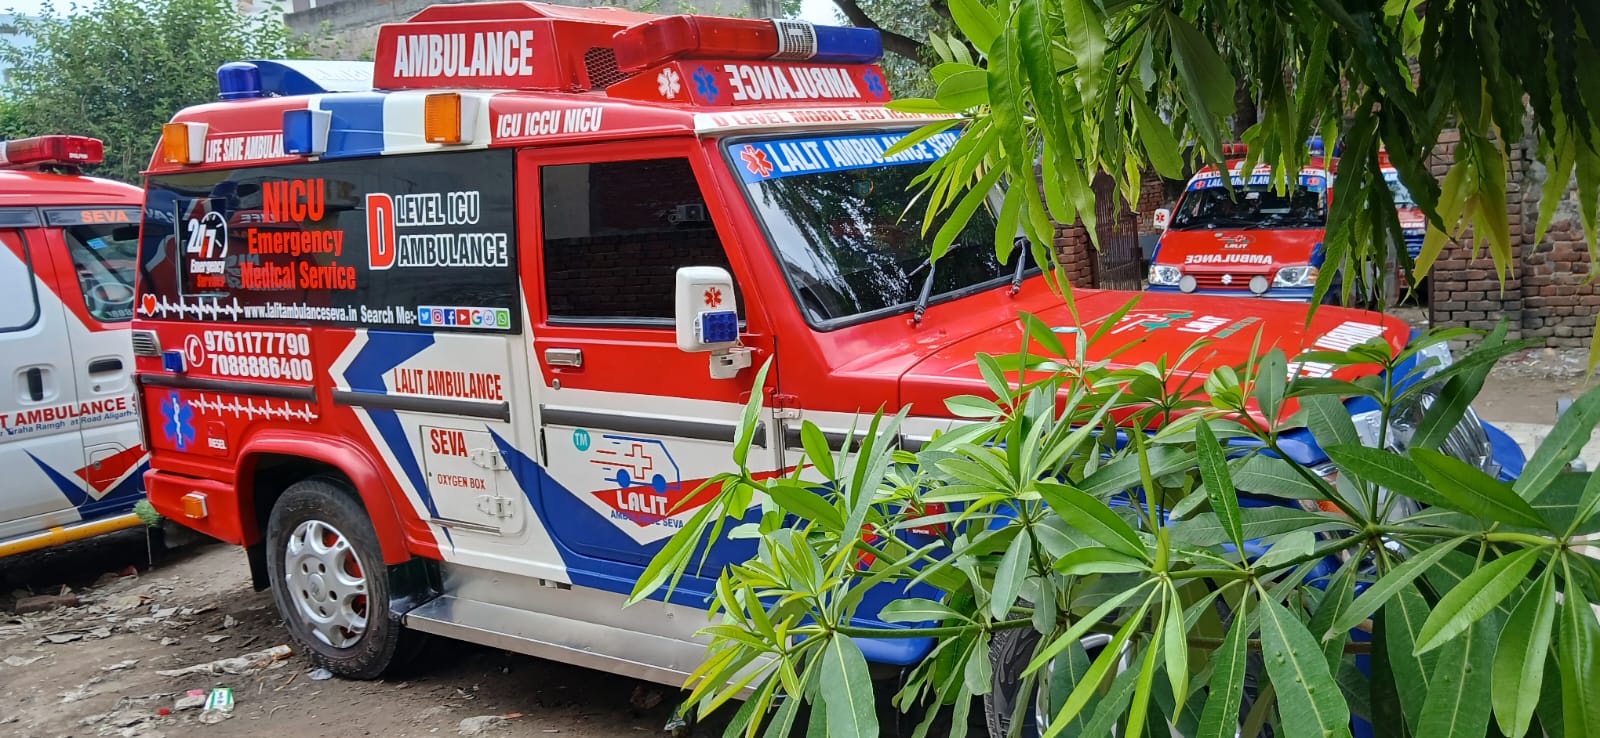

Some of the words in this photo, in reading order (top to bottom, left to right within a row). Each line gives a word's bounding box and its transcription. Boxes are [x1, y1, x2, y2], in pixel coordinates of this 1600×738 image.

[394, 30, 534, 78] AMBULANCE
[496, 113, 522, 138] ICU
[524, 110, 561, 136] ICCU
[563, 106, 603, 133] NICU
[205, 139, 223, 163] LIFE
[222, 137, 244, 161] SAVE
[244, 134, 286, 160] AMBULAN
[767, 141, 828, 173] LALIT
[262, 178, 325, 223] NICU
[395, 193, 446, 227] LEVEL
[447, 191, 480, 225] ICU
[81, 210, 129, 223] SEVA
[247, 228, 344, 257] Emergency
[366, 193, 396, 270] D
[398, 233, 509, 267] AMBULANCE
[300, 261, 357, 290] Service
[243, 302, 358, 322] www.lalitambulanceseva.in
[360, 305, 394, 324] Search
[204, 330, 310, 356] 9761177790
[207, 353, 314, 382] 7088886400
[394, 367, 424, 395] LALIT
[427, 370, 504, 401] AMBULANCE
[15, 397, 127, 427] AMBULANCE
[430, 428, 469, 458] SEVA
[574, 432, 588, 446] TM
[437, 473, 468, 488] OXYGEN
[470, 477, 486, 490] BOX
[616, 489, 668, 517] LALIT
[662, 518, 684, 529] SEVA
